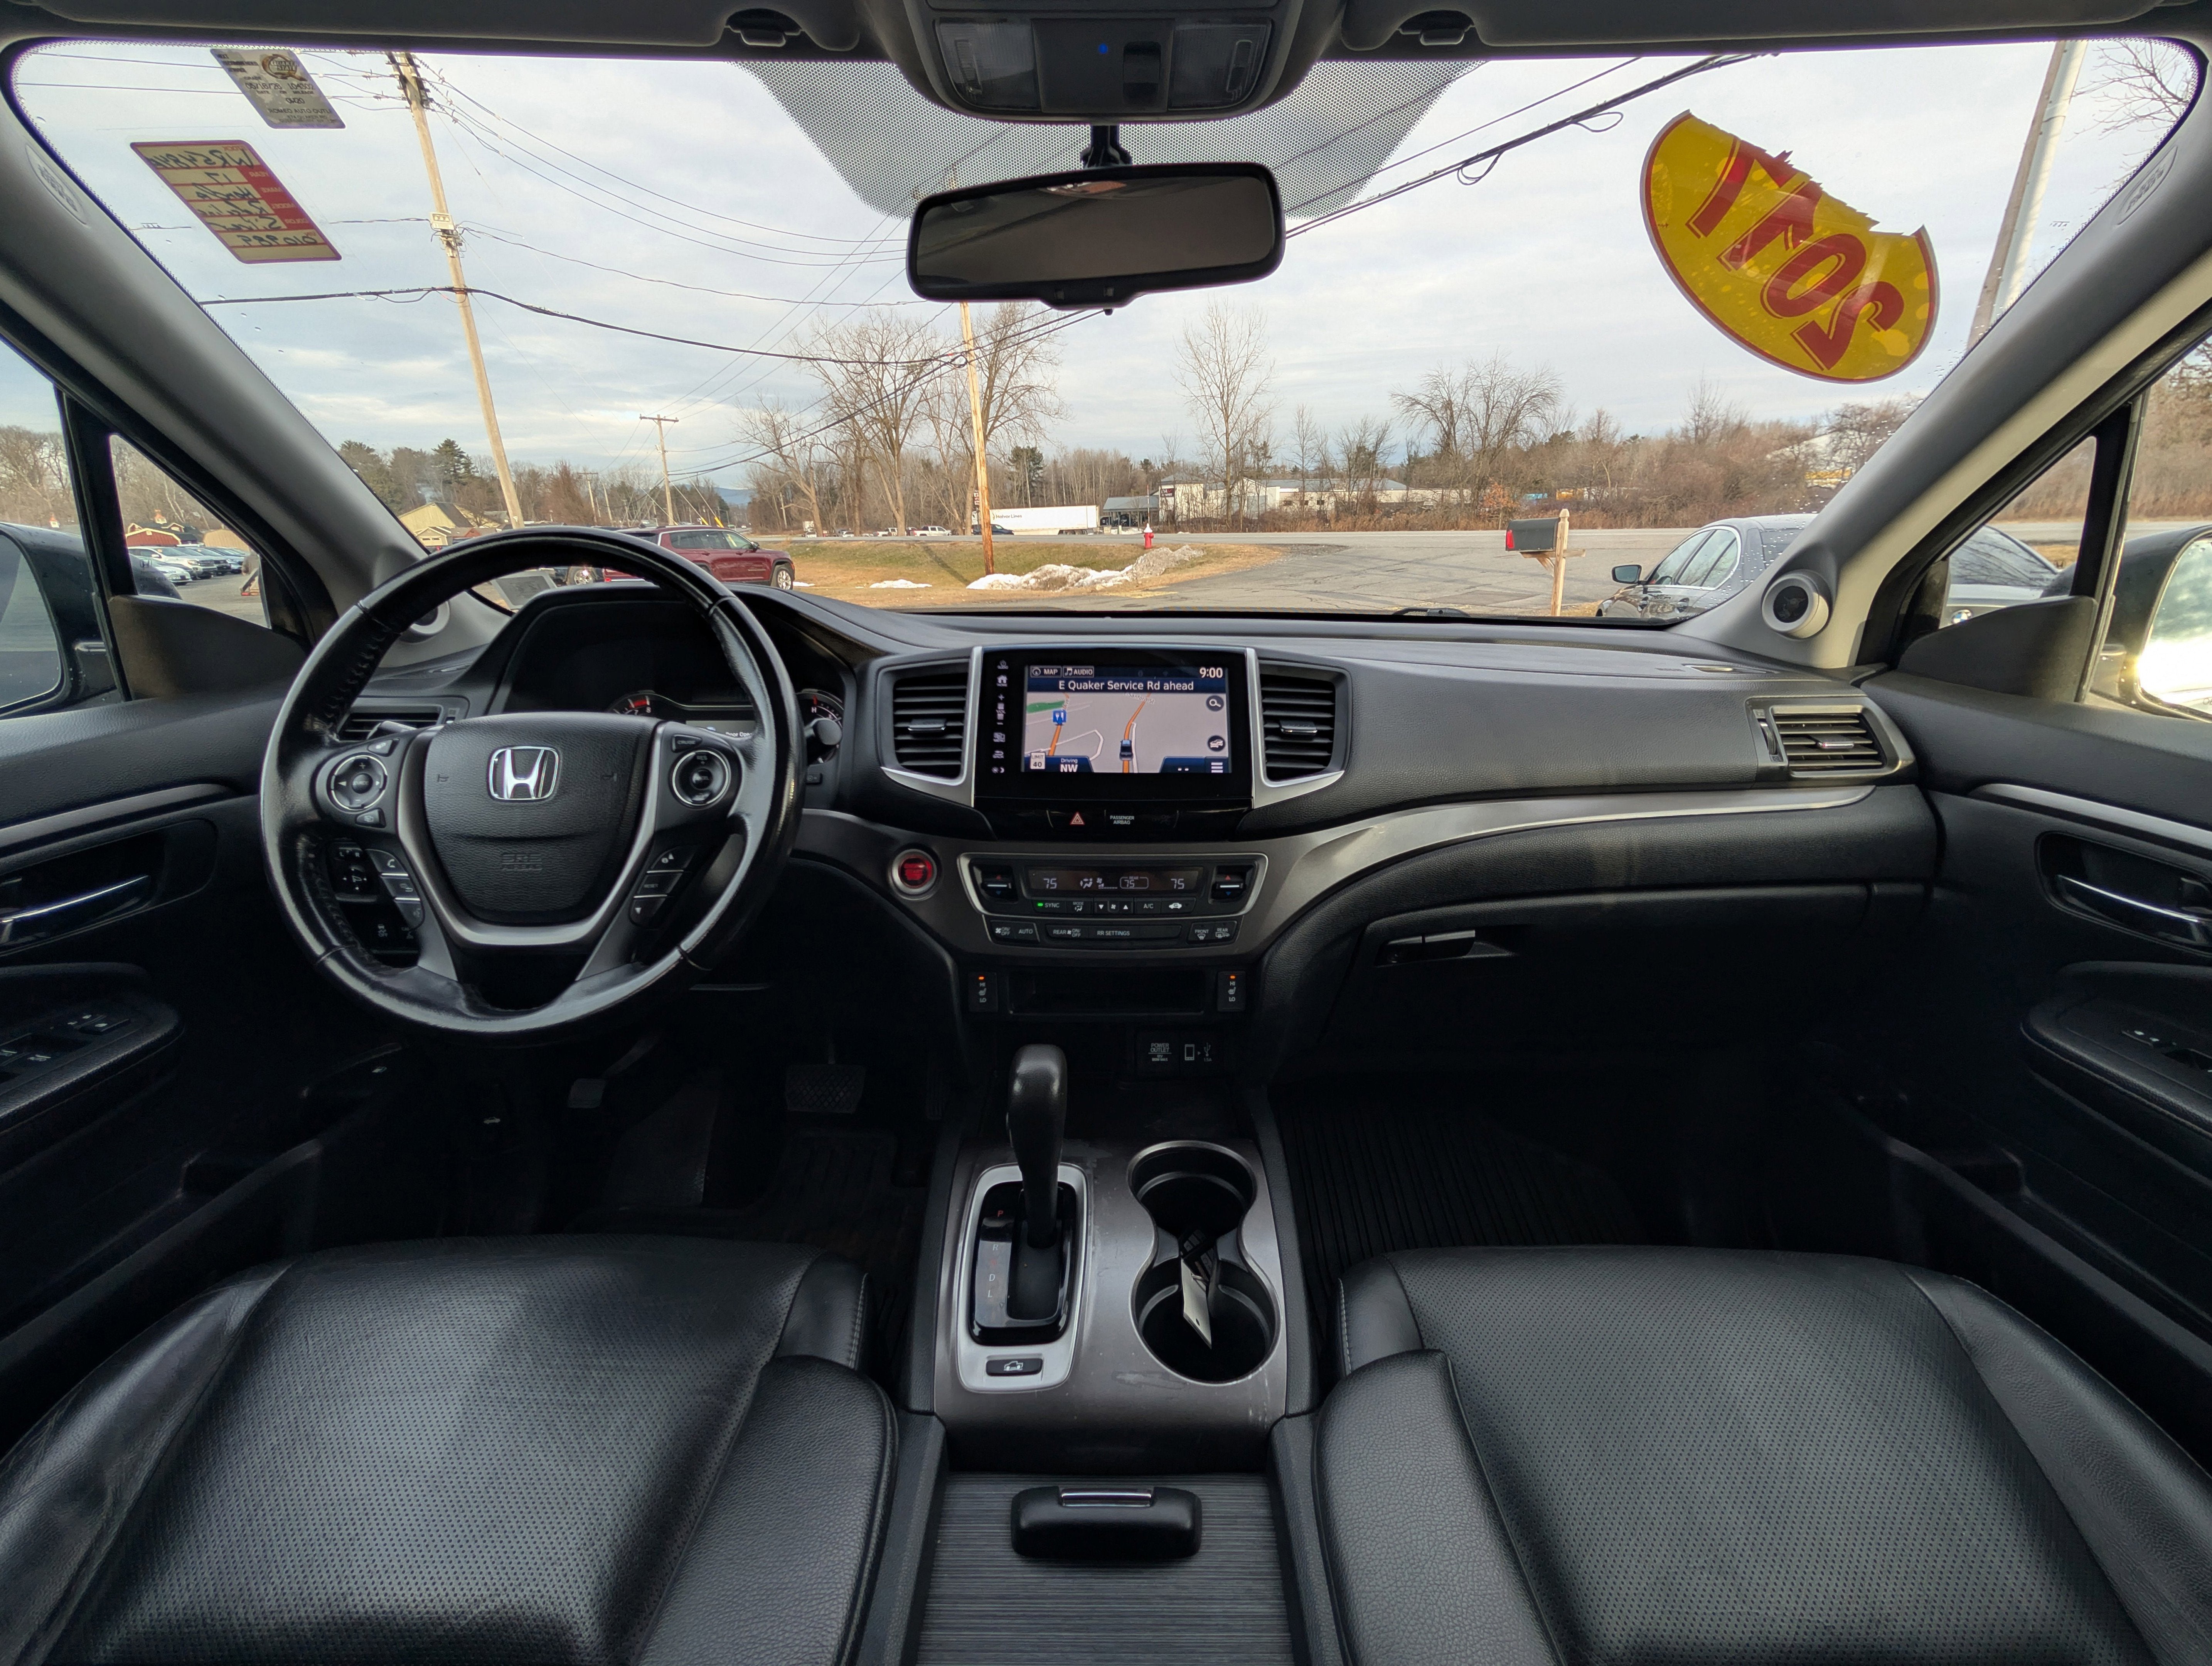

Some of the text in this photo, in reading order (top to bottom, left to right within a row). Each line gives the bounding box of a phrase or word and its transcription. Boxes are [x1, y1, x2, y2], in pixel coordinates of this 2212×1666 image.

[1199, 667, 1223, 678] 9:00
[1059, 680, 1194, 691] E Quaker Service Rd ahead
[1060, 764, 1078, 772] NW
[1043, 878, 1058, 889] 75
[1124, 879, 1135, 888] 75
[1171, 878, 1185, 889] 75
[989, 1273, 996, 1282] D
[988, 1290, 993, 1298] L
